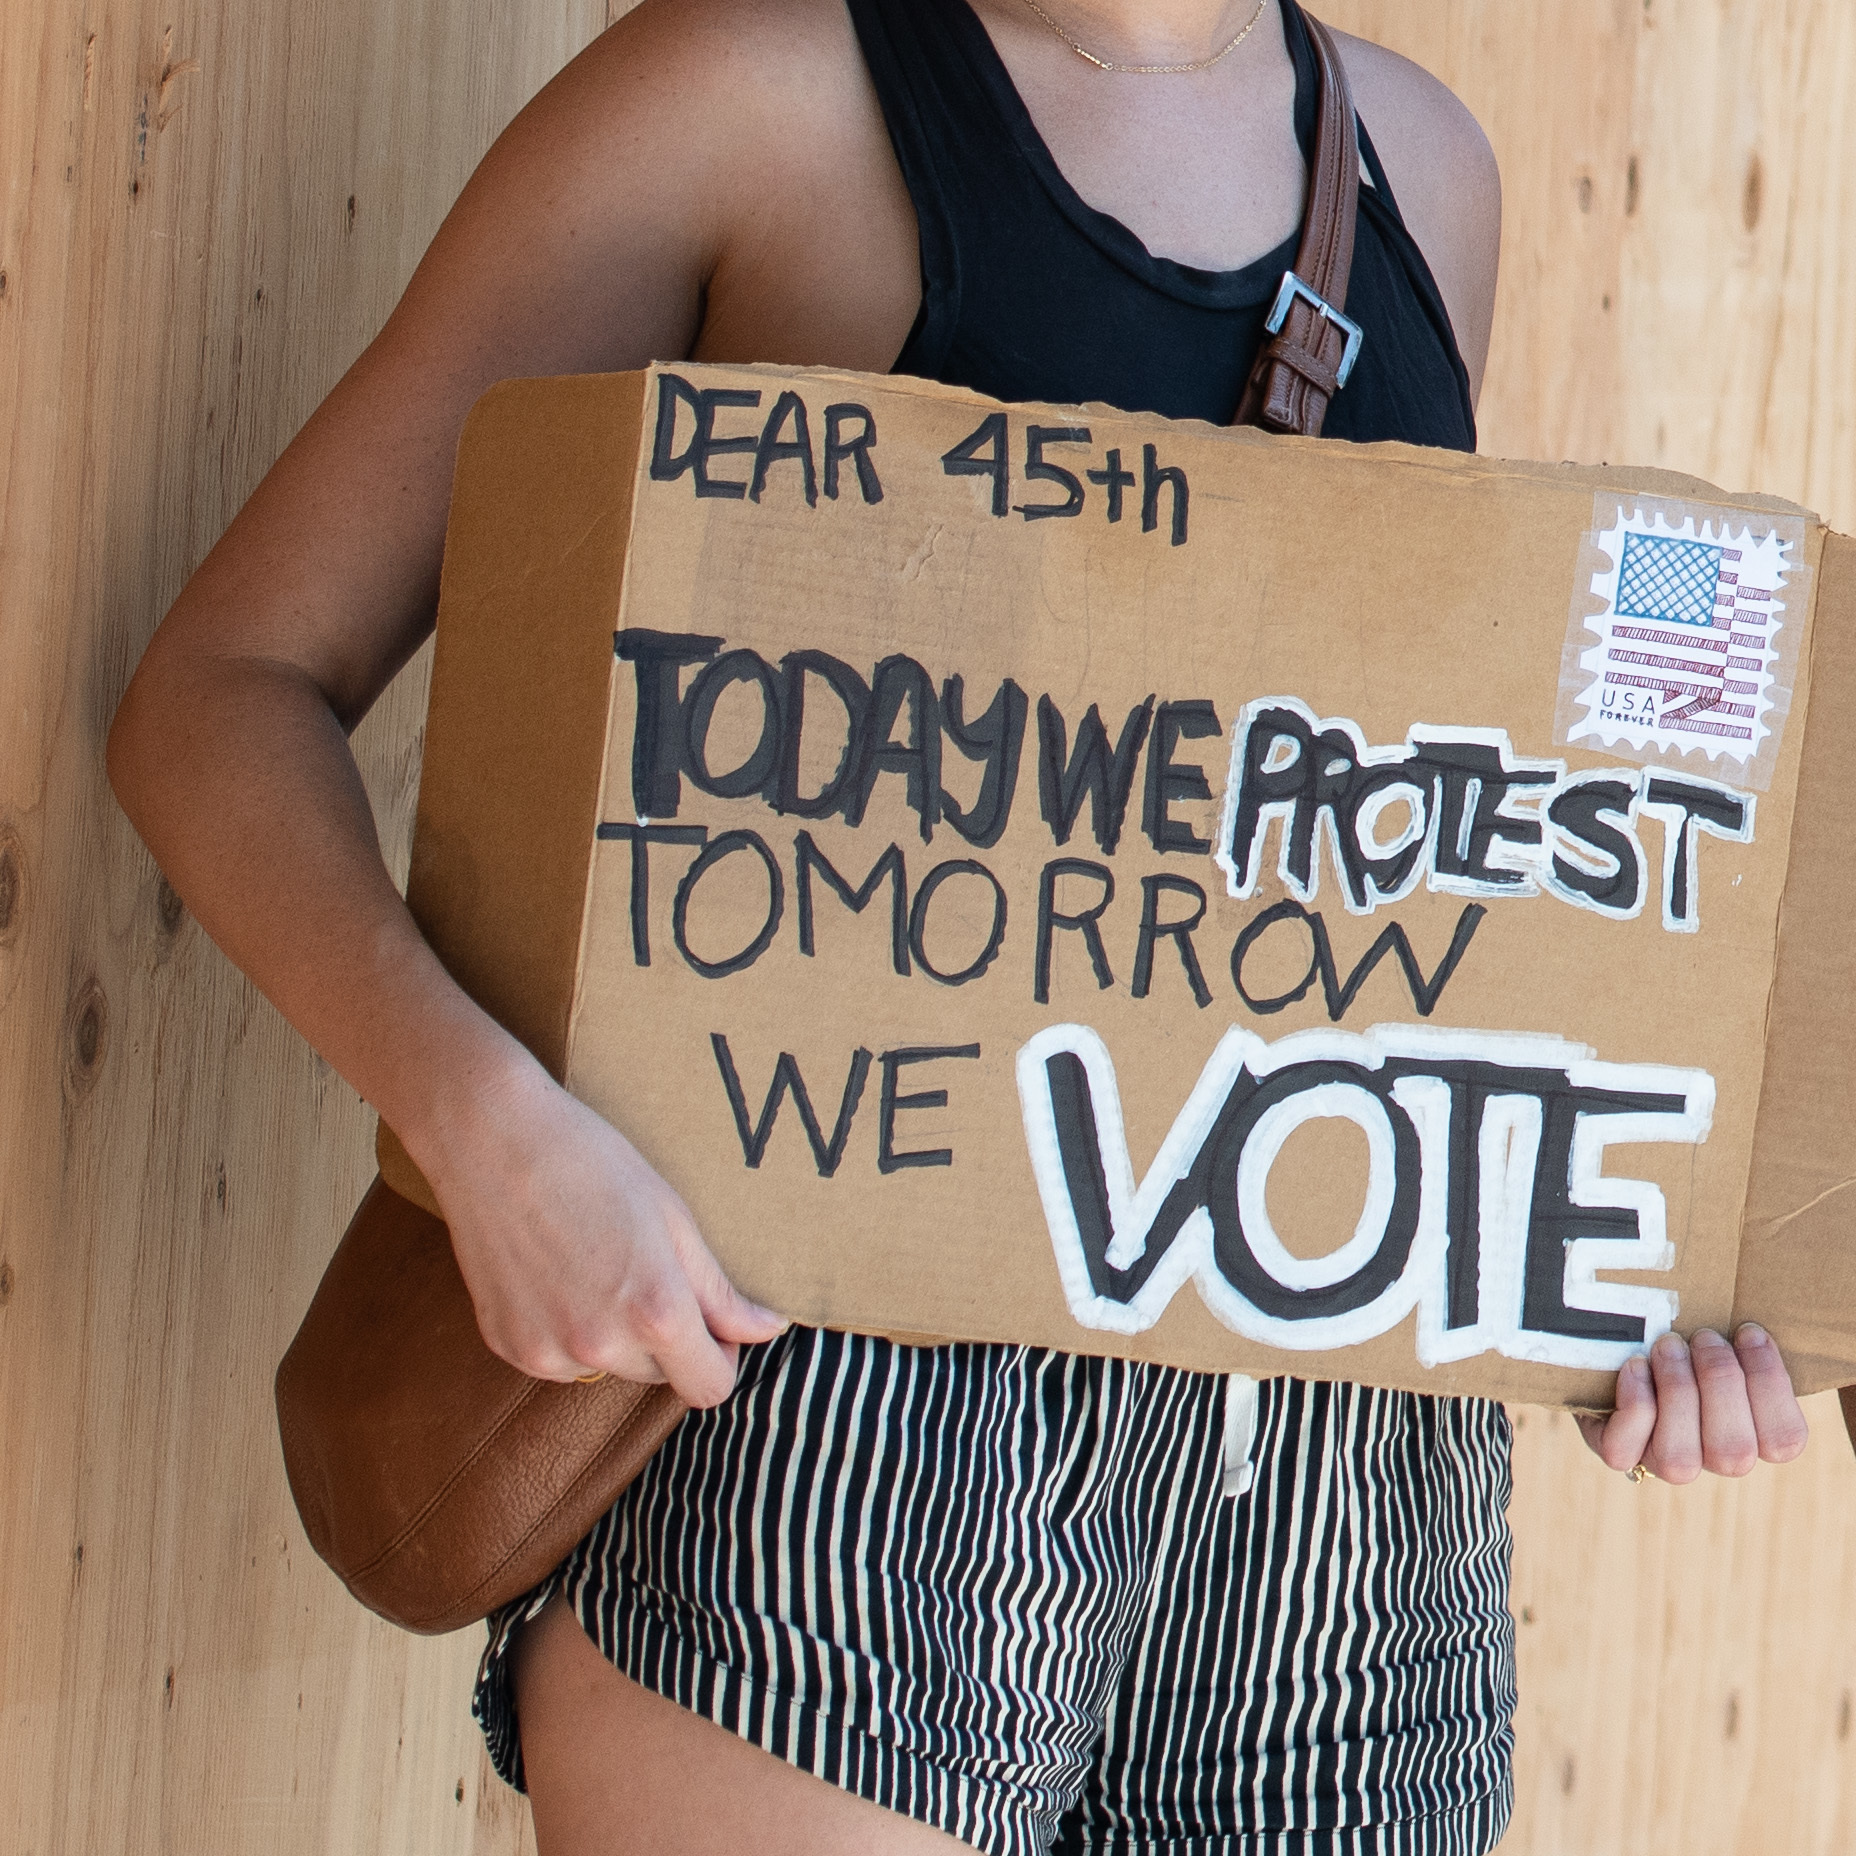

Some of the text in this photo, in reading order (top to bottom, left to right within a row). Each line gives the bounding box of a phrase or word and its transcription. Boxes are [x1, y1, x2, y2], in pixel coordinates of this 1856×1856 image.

[650, 372, 1190, 548] DEAR 45th
[612, 627, 1756, 934] TODAY WE PROTEST
[1599, 709, 1654, 727] FOREVER
[1601, 688, 1656, 715] USA
[598, 822, 1487, 1022] TOMORROW
[709, 1023, 1716, 1370] WE VOTE
